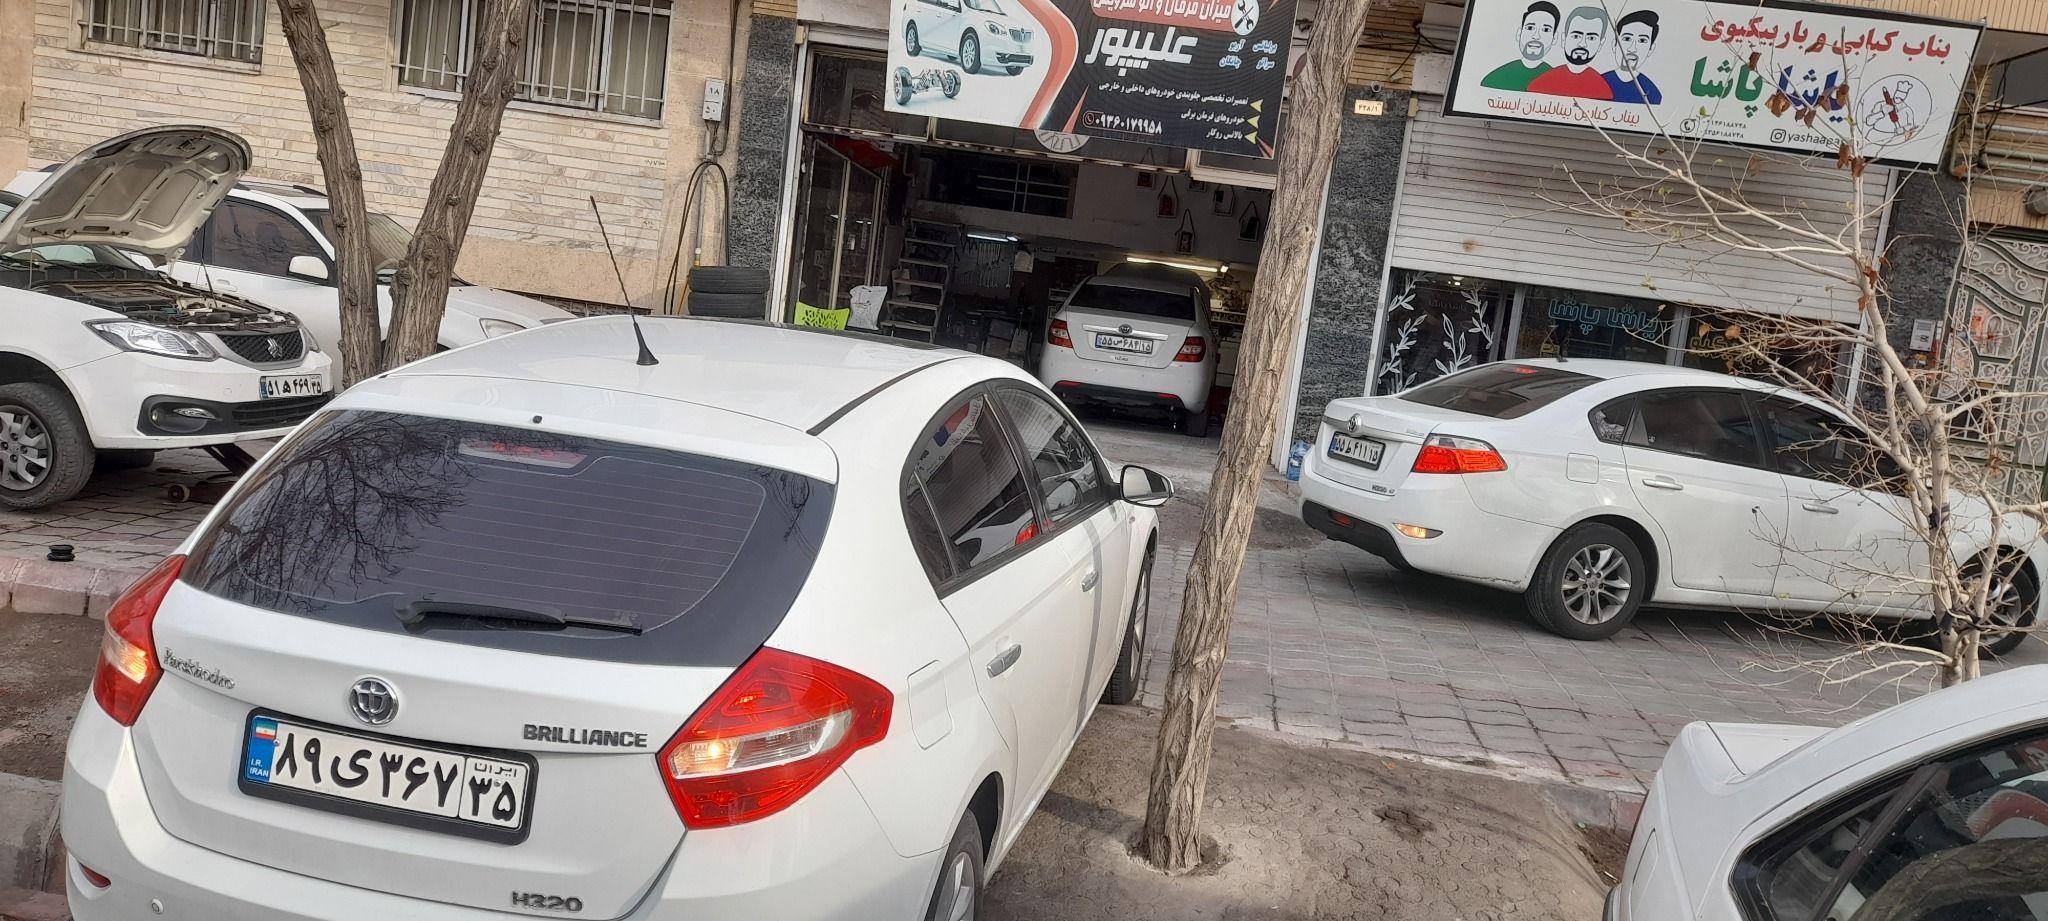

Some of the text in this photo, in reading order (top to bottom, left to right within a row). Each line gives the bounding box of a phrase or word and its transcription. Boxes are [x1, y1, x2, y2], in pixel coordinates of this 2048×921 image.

[1083, 26, 1199, 77] علیپور
[1831, 27, 1900, 57] کبابی
[1902, 34, 1951, 65] بناب
[1098, 81, 1120, 92] خارجی
[1125, 83, 1145, 95] داخلی
[1689, 56, 1764, 119] پاشا
[523, 723, 649, 749] BRILLIANCE
[249, 767, 270, 778] IRAN
[250, 758, 264, 768] I.R.
[473, 761, 518, 779] ایران
[511, 890, 584, 913] H320
